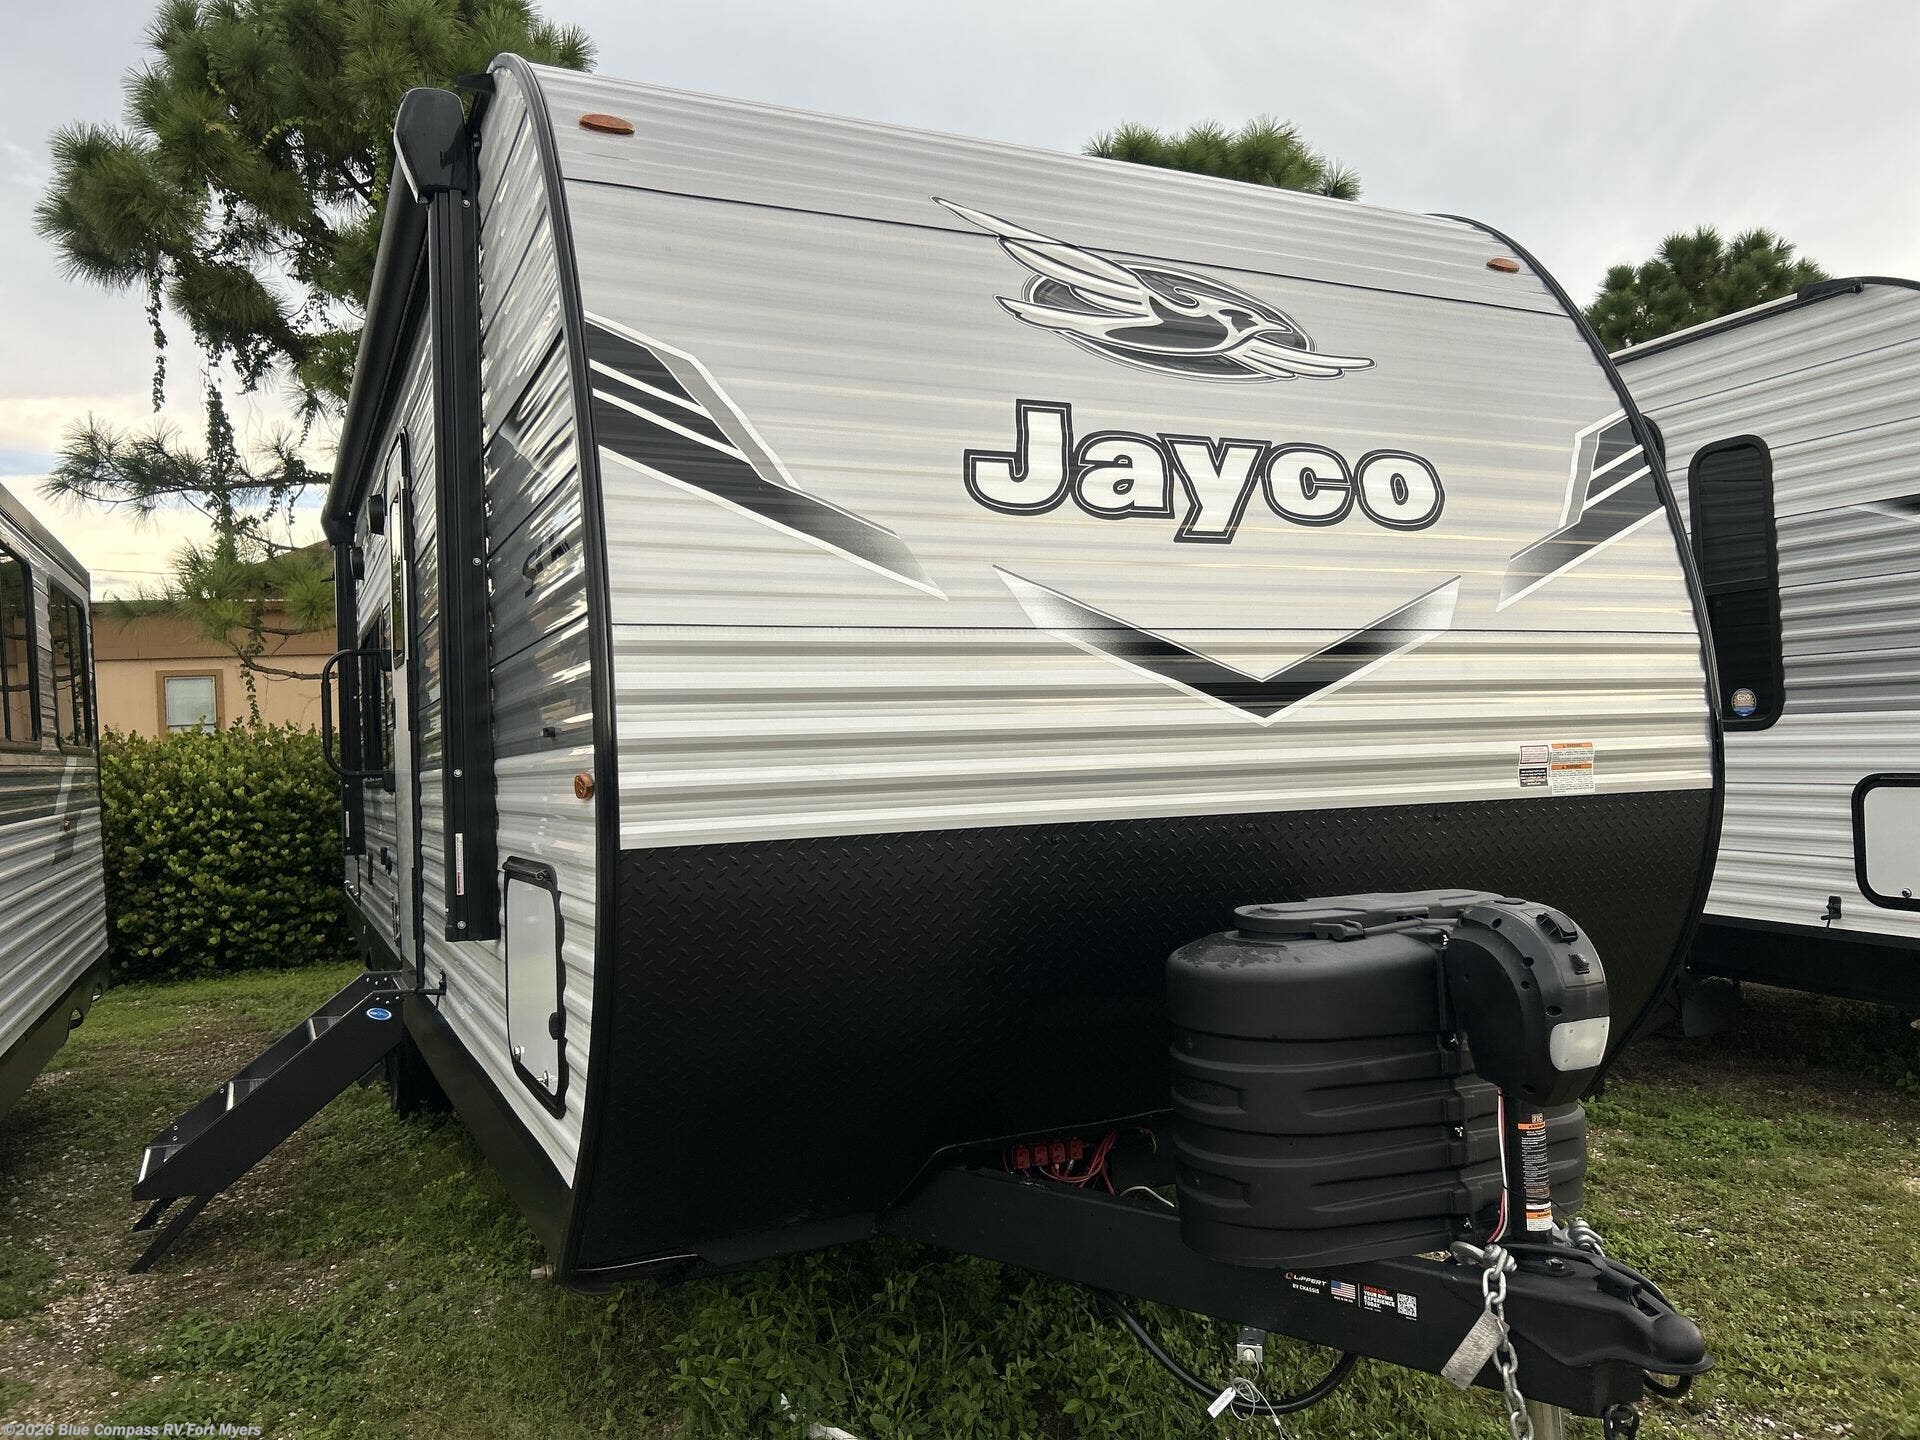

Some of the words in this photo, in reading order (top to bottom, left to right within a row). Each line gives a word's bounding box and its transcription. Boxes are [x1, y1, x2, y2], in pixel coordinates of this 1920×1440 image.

[963, 398, 1445, 544] Jayco
[1300, 1285, 1320, 1294] CHASSIS
[1363, 1290, 1378, 1299] YOUR
[1363, 1295, 1396, 1308] EXPERIENCE
[1364, 1300, 1382, 1309] TODAY.
